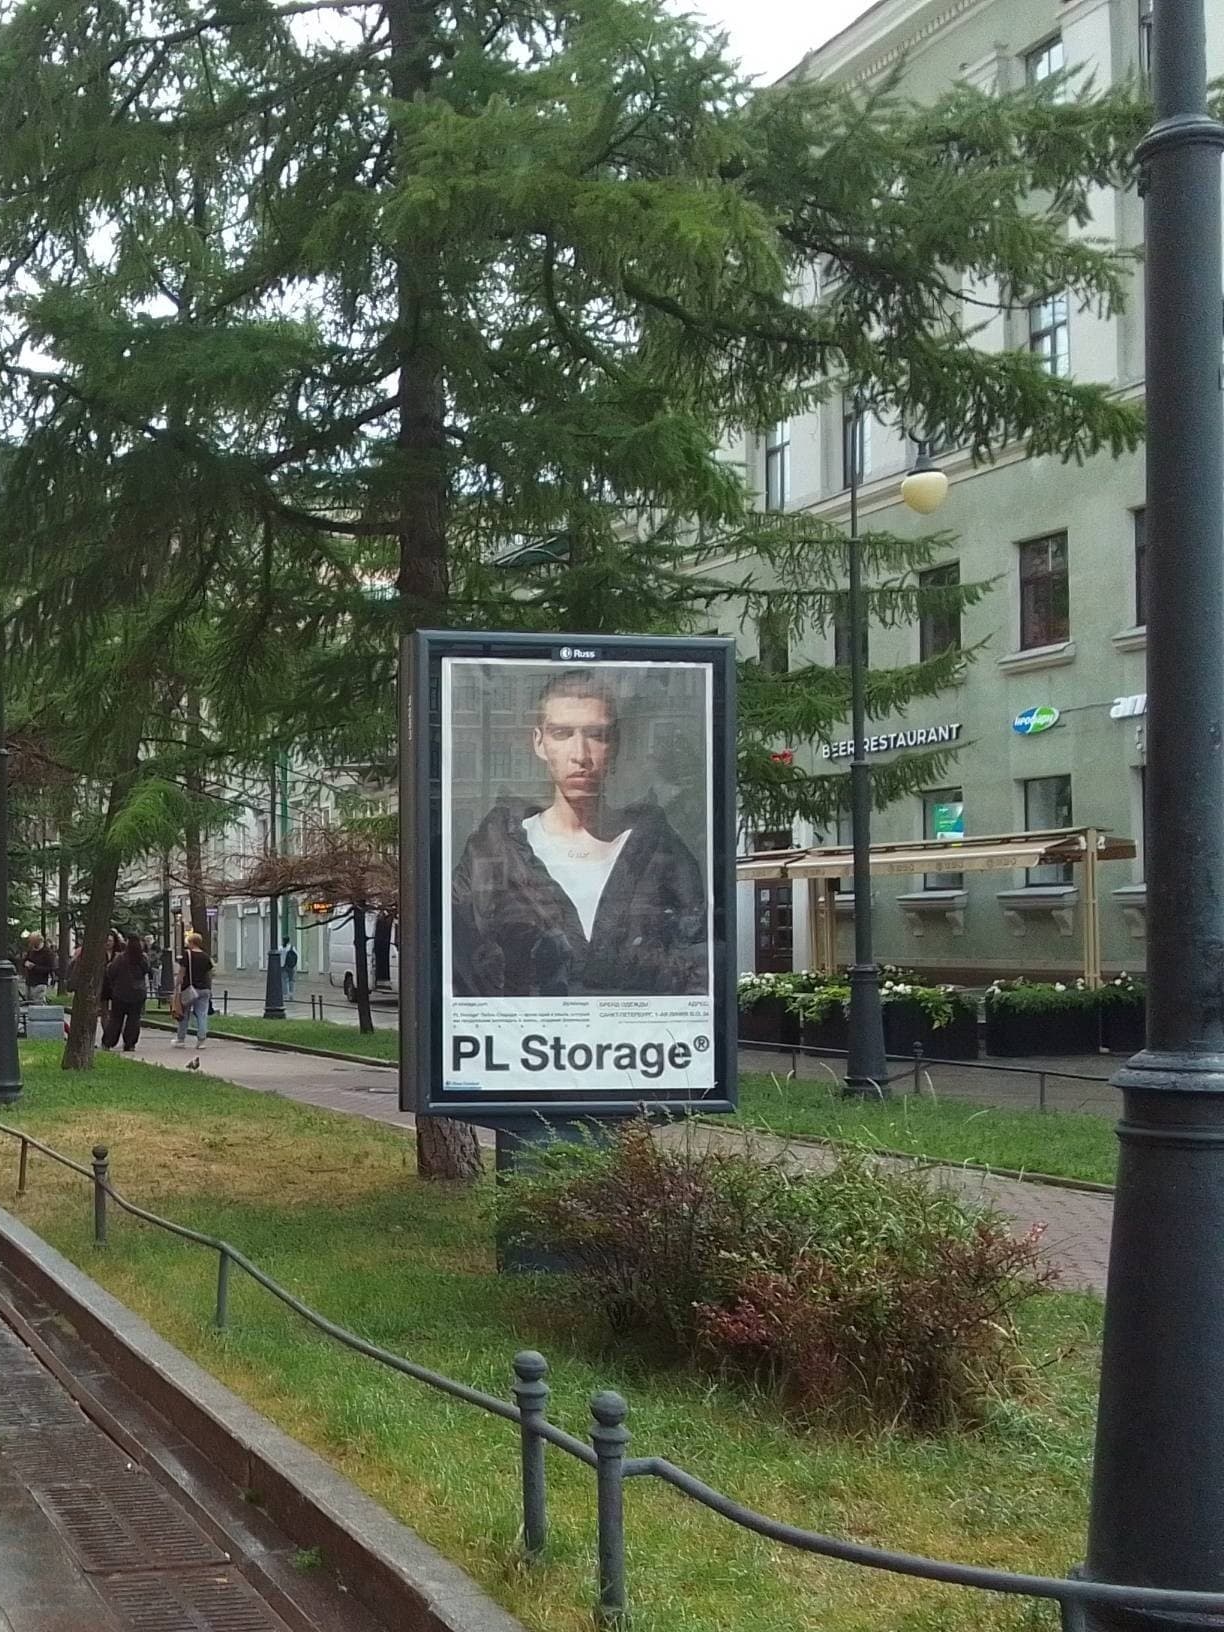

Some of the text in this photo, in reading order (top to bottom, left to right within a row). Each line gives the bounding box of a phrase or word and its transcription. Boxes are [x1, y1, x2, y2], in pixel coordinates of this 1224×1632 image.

[822, 723, 961, 759] BEER RESTAURANT
[452, 1035, 510, 1071] PL
